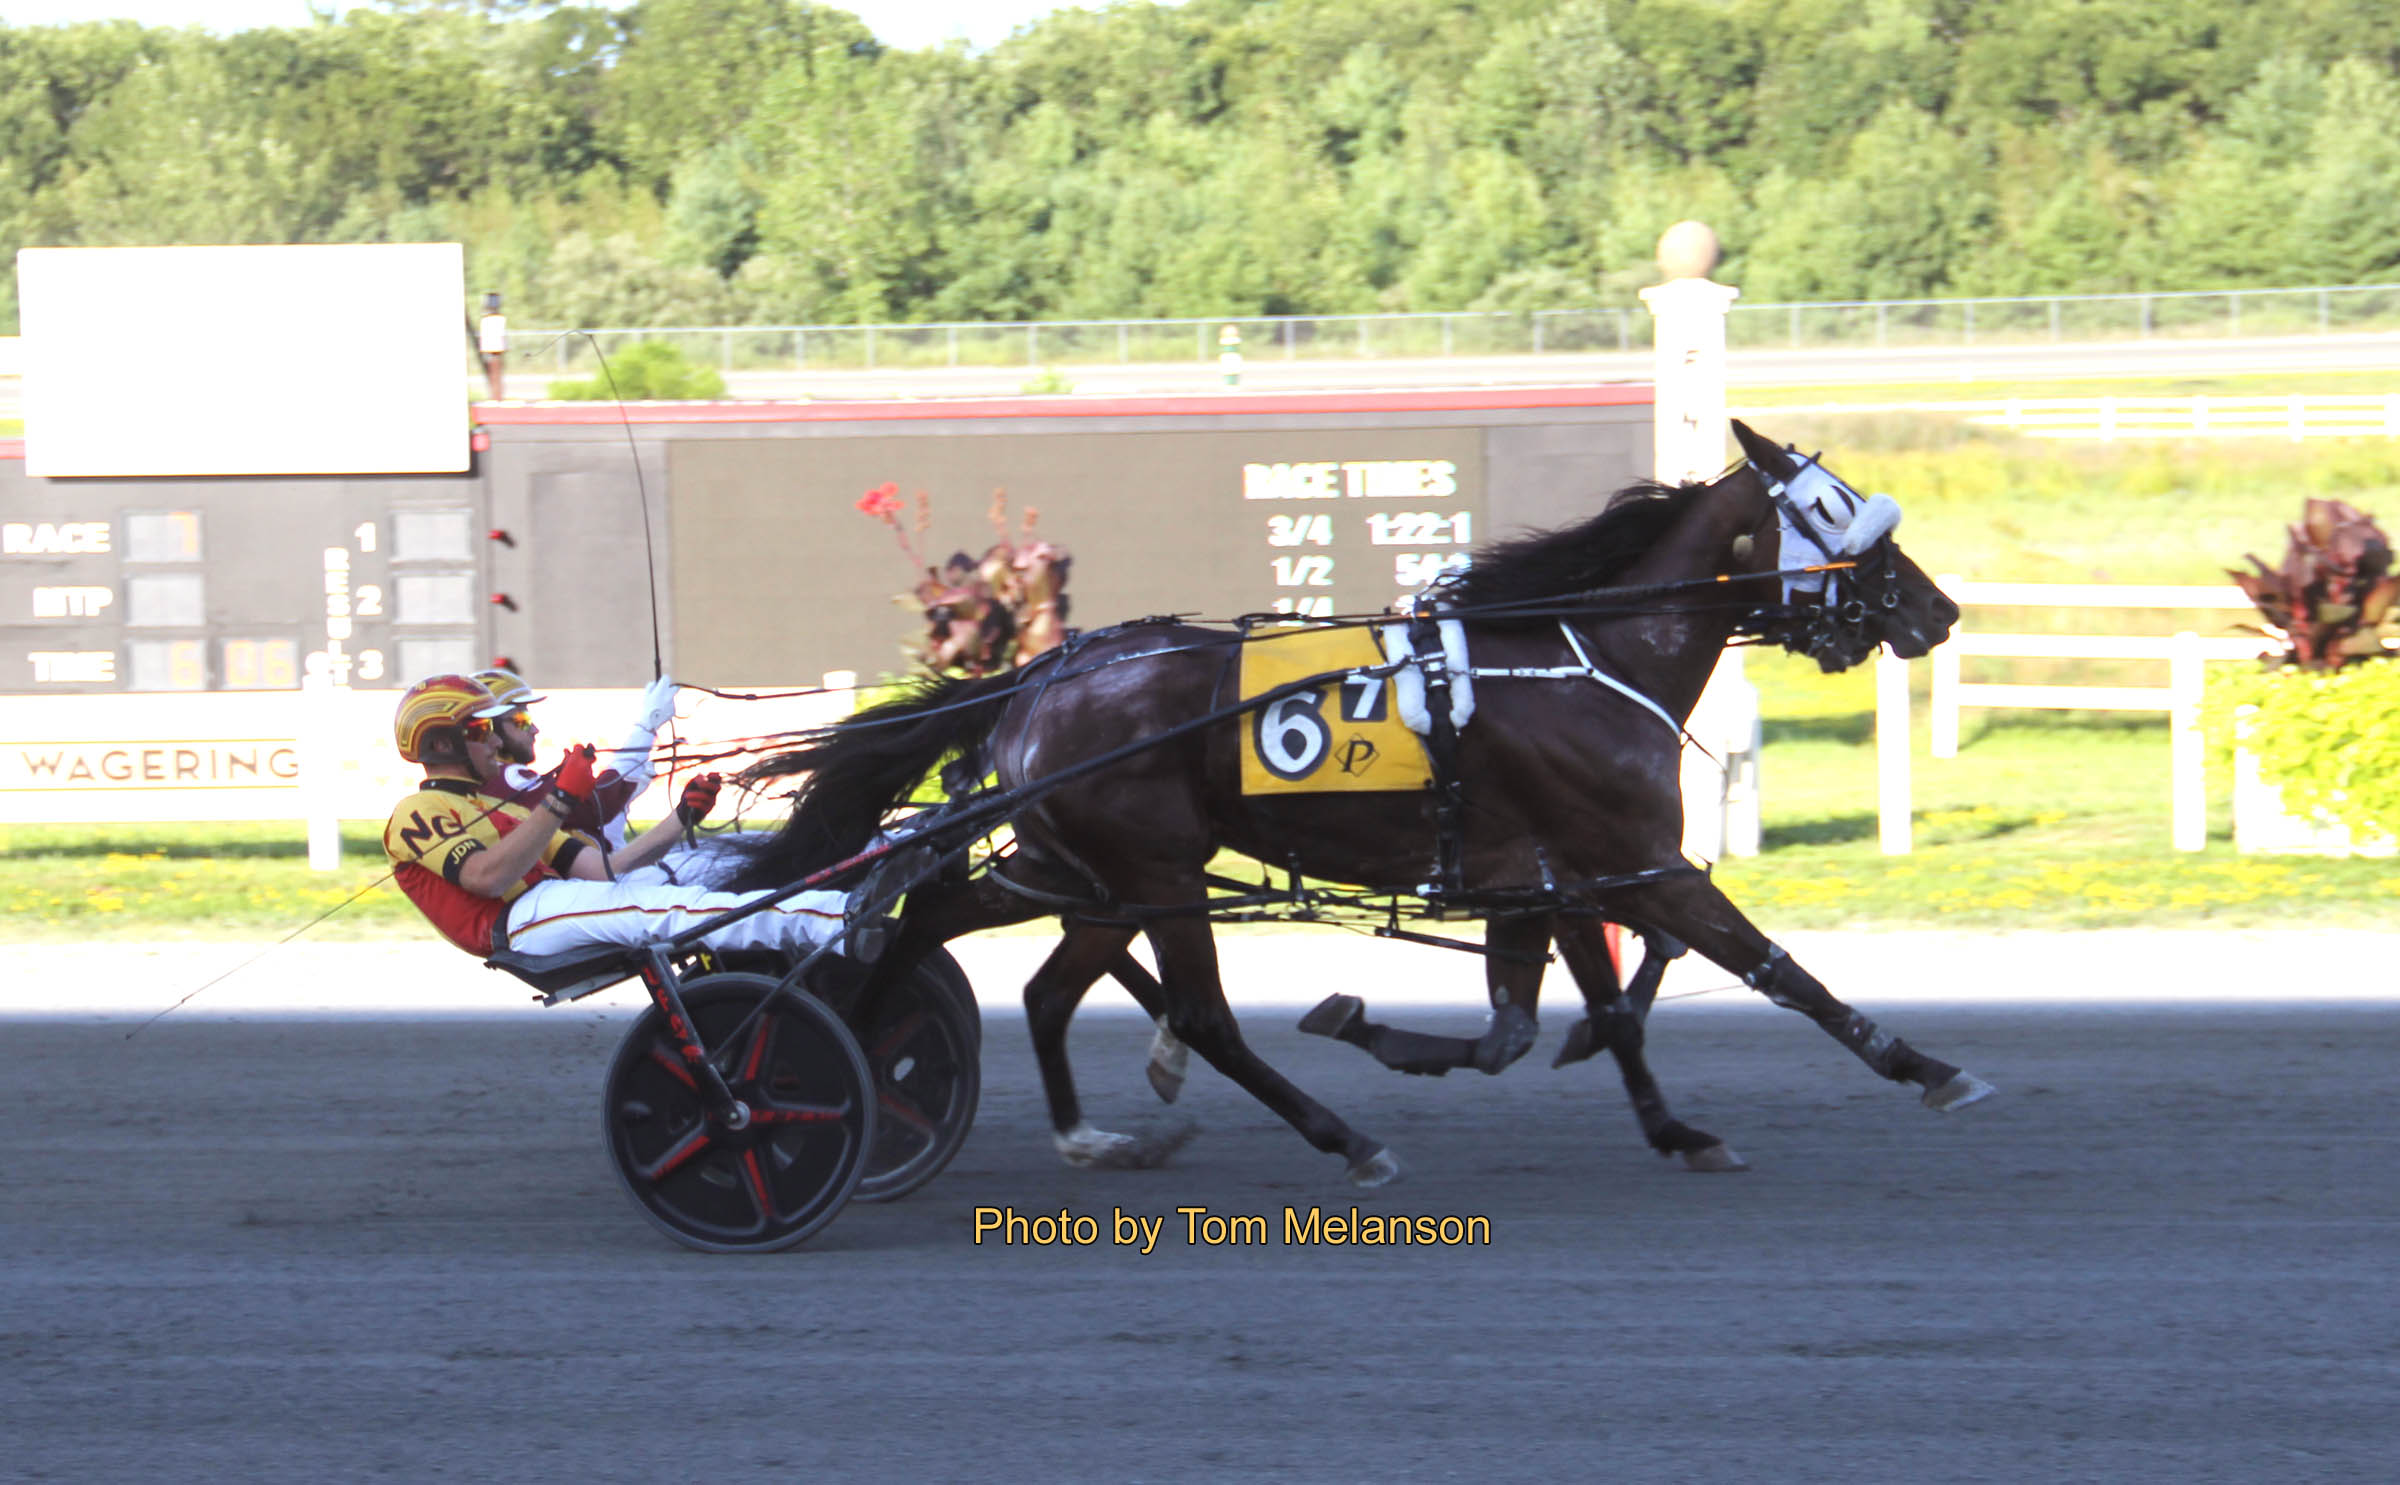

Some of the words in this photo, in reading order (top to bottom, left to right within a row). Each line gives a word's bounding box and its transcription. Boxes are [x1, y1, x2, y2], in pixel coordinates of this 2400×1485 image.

[1243, 462, 1340, 499] RACE
[1342, 460, 1457, 497] TIMES
[2, 522, 111, 553] RACE
[354, 522, 377, 552] 1
[1267, 514, 1333, 547] 3/4
[1271, 555, 1335, 586] 1/2
[355, 585, 382, 616] 2
[28, 652, 116, 682] TIME
[358, 650, 384, 679] 3
[1344, 674, 1384, 719] 7
[1257, 689, 1328, 777] 6
[22, 748, 299, 782] WAGERING
